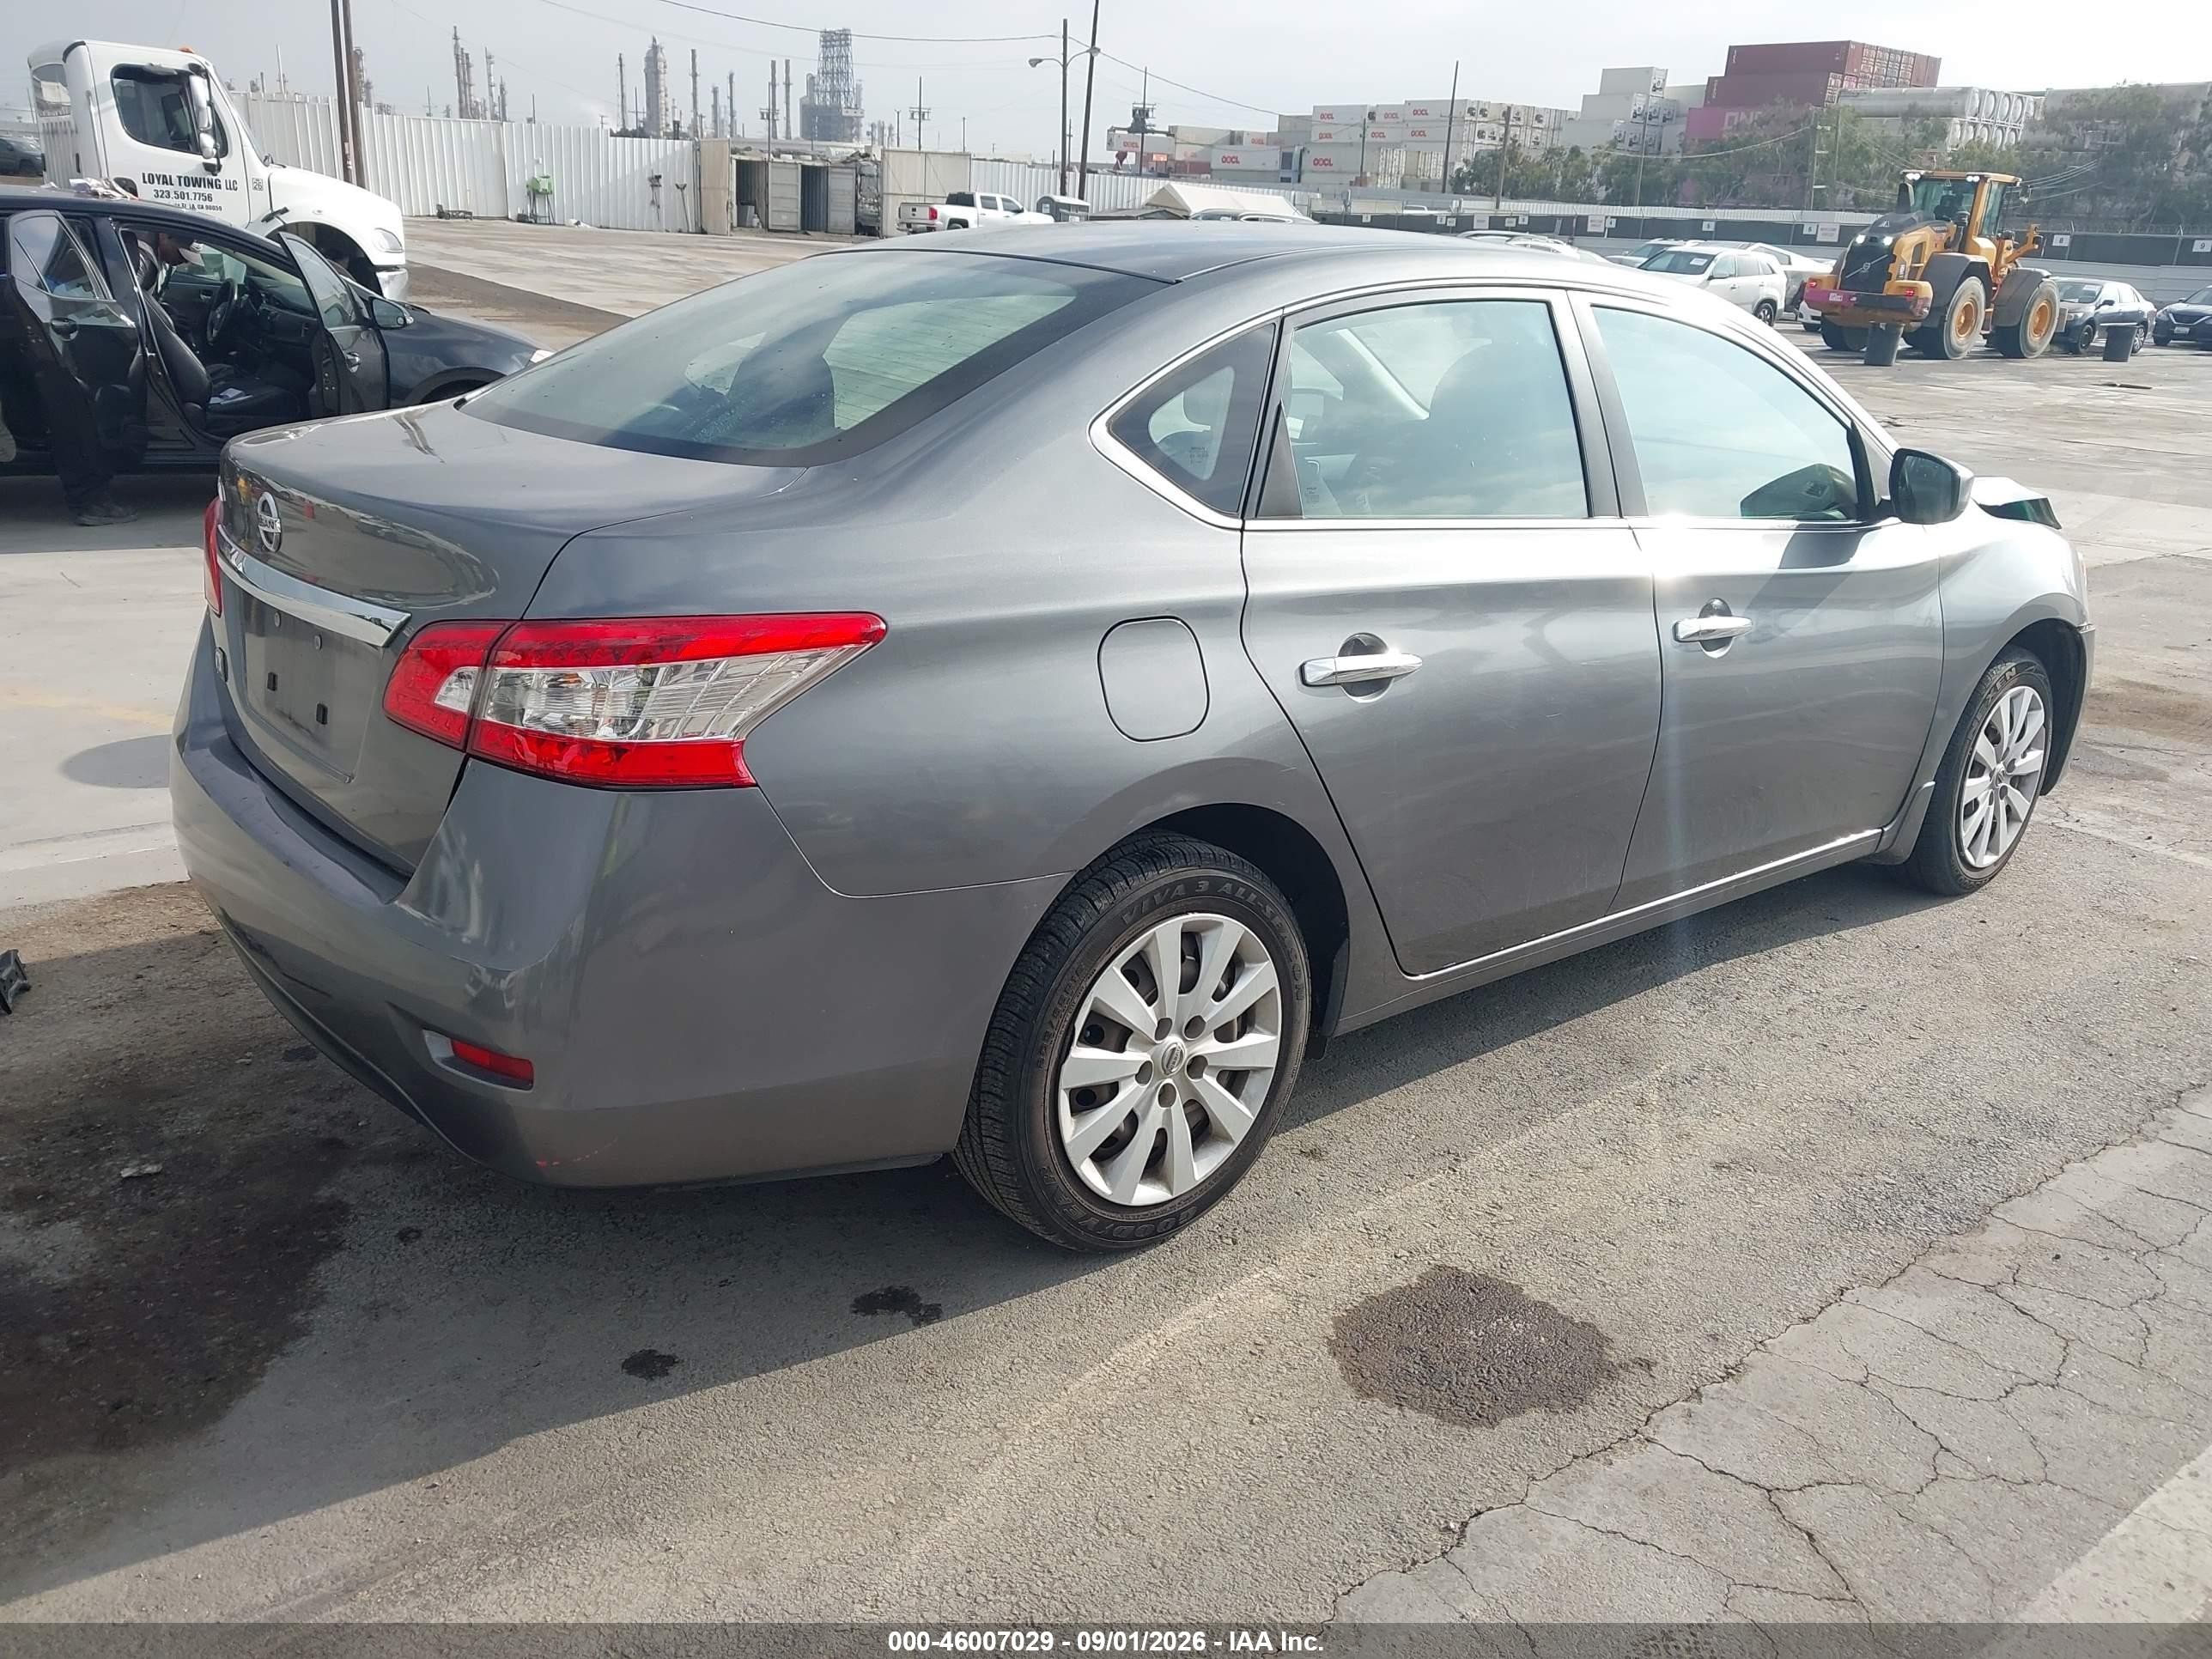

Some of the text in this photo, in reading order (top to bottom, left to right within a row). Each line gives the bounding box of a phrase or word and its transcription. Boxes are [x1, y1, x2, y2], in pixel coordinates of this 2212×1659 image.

[142, 172, 238, 191] LOYAL TOWING LLC
[253, 180, 262, 190] 26
[153, 188, 213, 202] 323.501.7756
[1121, 884, 1187, 925] VIVA
[1194, 880, 1210, 891] 3
